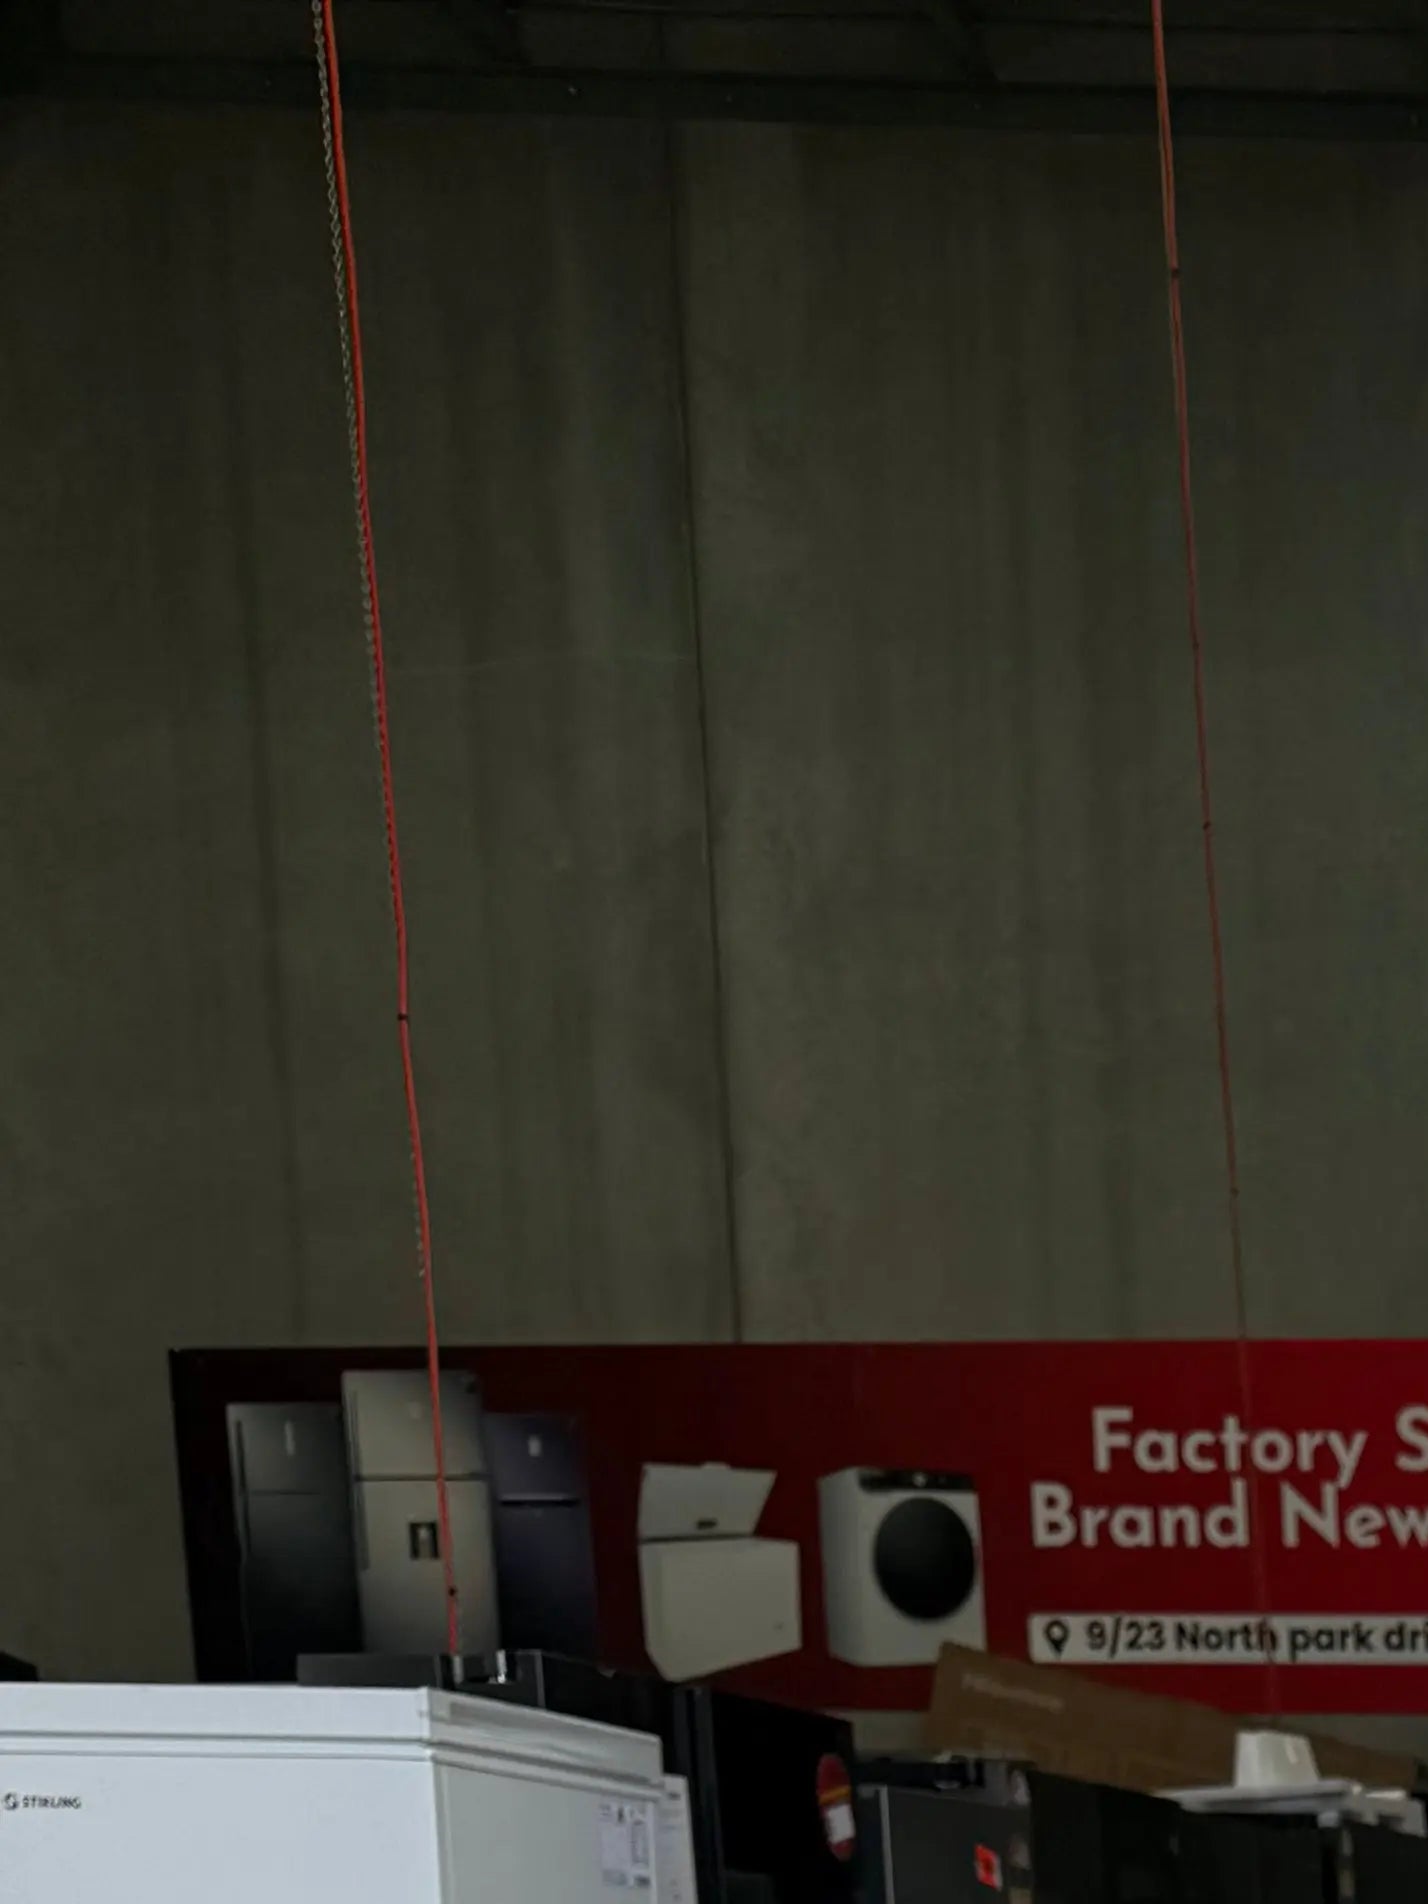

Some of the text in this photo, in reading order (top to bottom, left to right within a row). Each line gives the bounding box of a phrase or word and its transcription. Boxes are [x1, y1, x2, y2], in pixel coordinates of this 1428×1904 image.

[1091, 1404, 1369, 1491] Factory
[1029, 1476, 1252, 1549] Brand
[1087, 1617, 1166, 1658] 9/23
[1174, 1618, 1279, 1650] North
[1290, 1616, 1375, 1659] park
